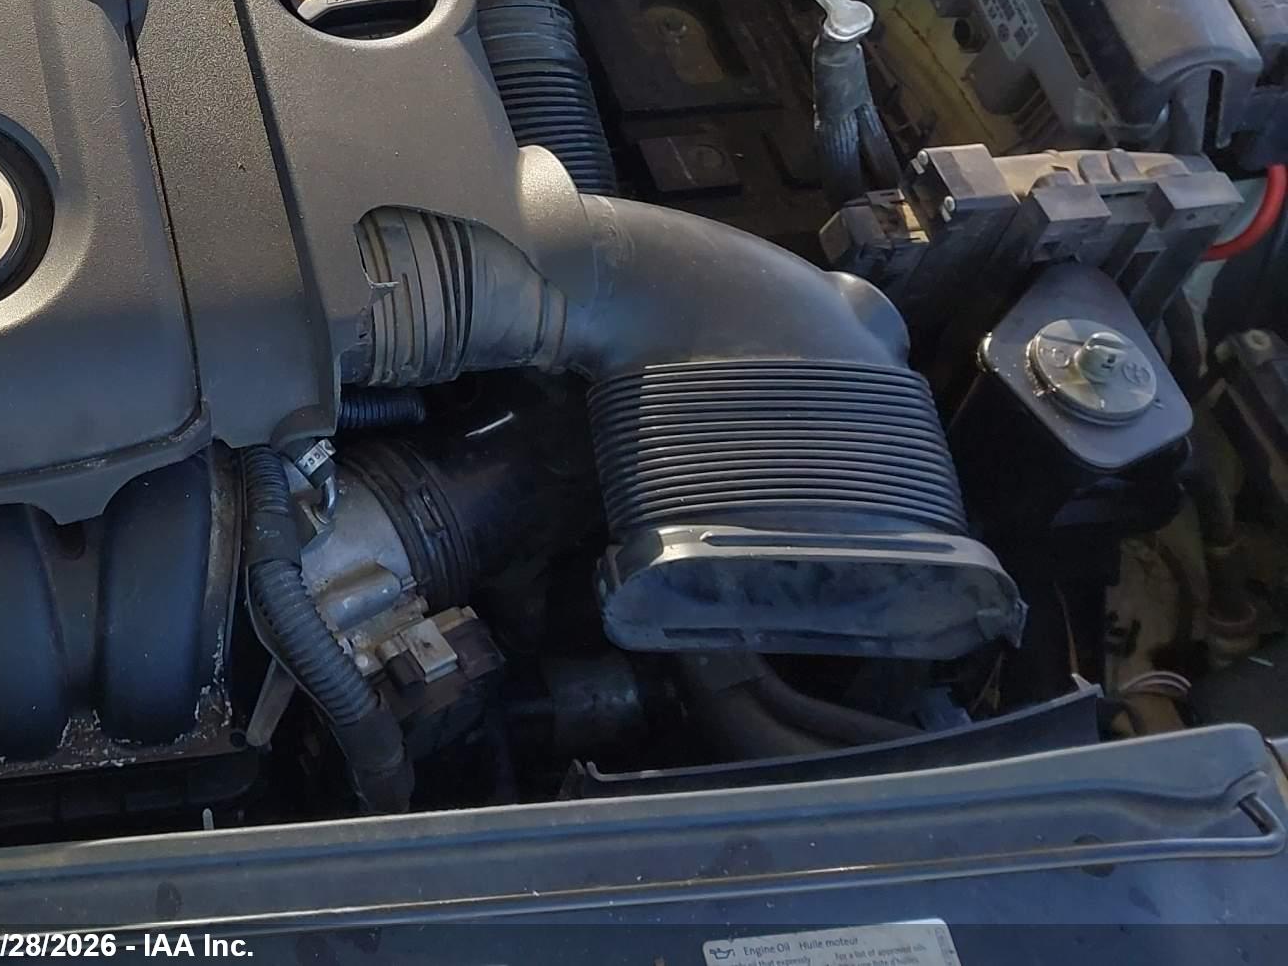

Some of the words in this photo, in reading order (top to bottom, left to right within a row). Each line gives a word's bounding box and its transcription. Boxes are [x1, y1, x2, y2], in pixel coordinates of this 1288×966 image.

[743, 945, 776, 958] Engine
[776, 942, 791, 953] Oil
[799, 940, 823, 951] Huile
[825, 937, 858, 949] moteur
